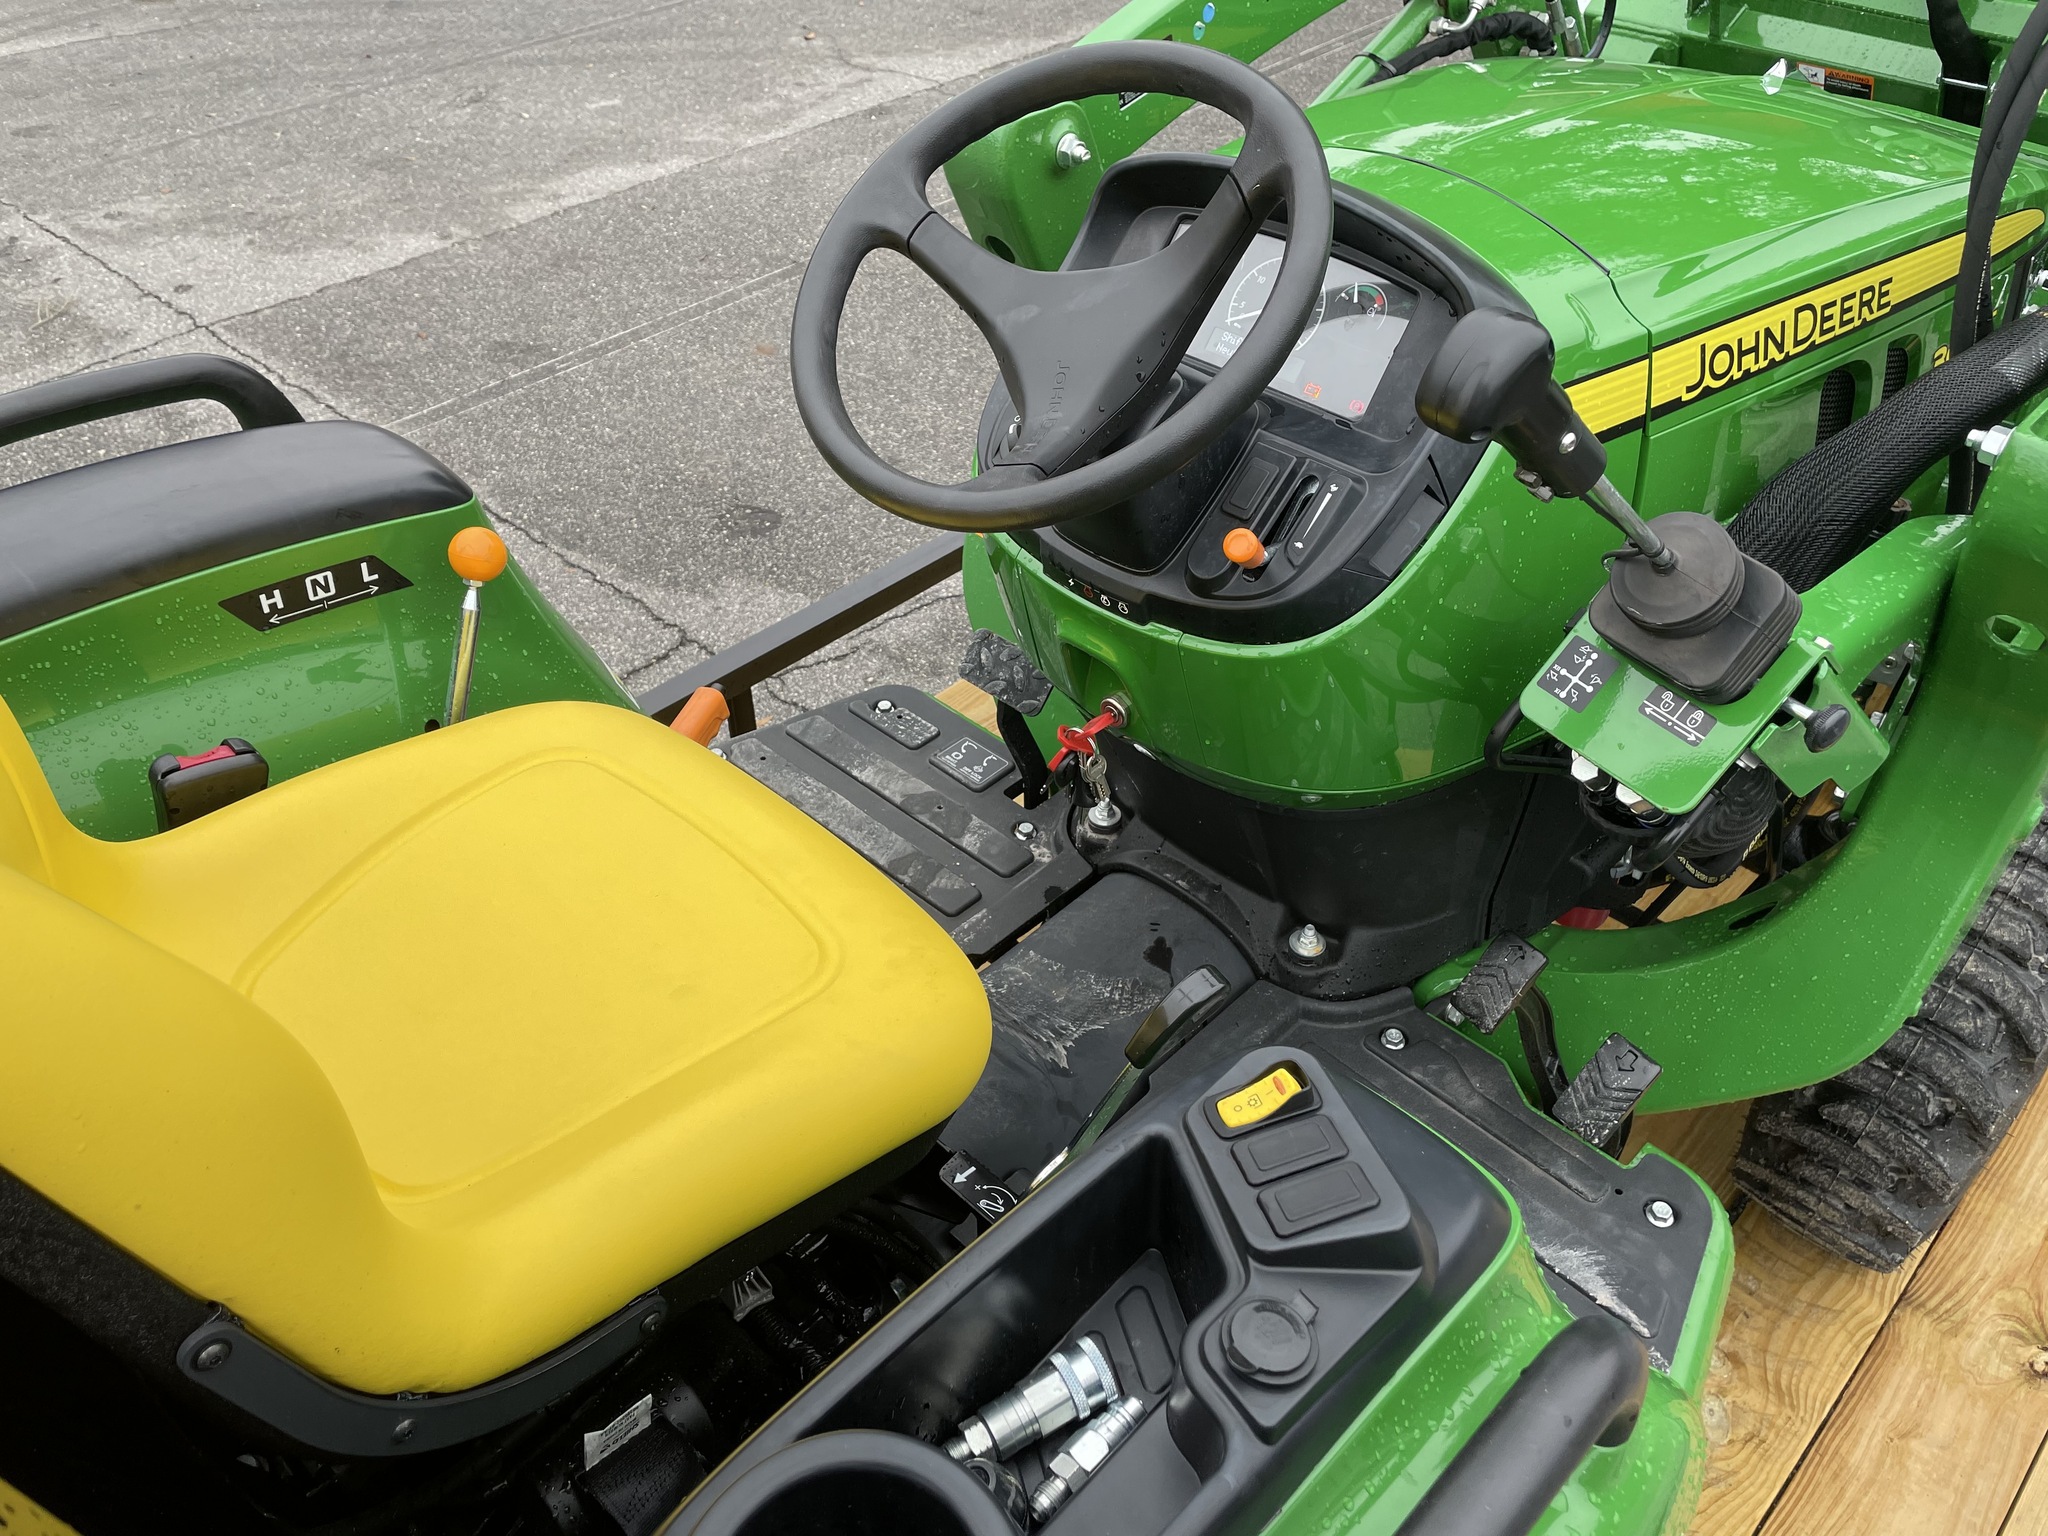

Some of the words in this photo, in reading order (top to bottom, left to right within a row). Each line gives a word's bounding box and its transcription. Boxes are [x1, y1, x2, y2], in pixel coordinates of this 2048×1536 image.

[1239, 301, 1246, 309] 5
[1256, 275, 1266, 284] 10
[1685, 319, 1786, 392] JOHN
[1792, 276, 1894, 349] DEERE
[1049, 360, 1071, 413] JOHN
[259, 589, 284, 614] H
[310, 574, 331, 597] N
[360, 561, 379, 583] L
